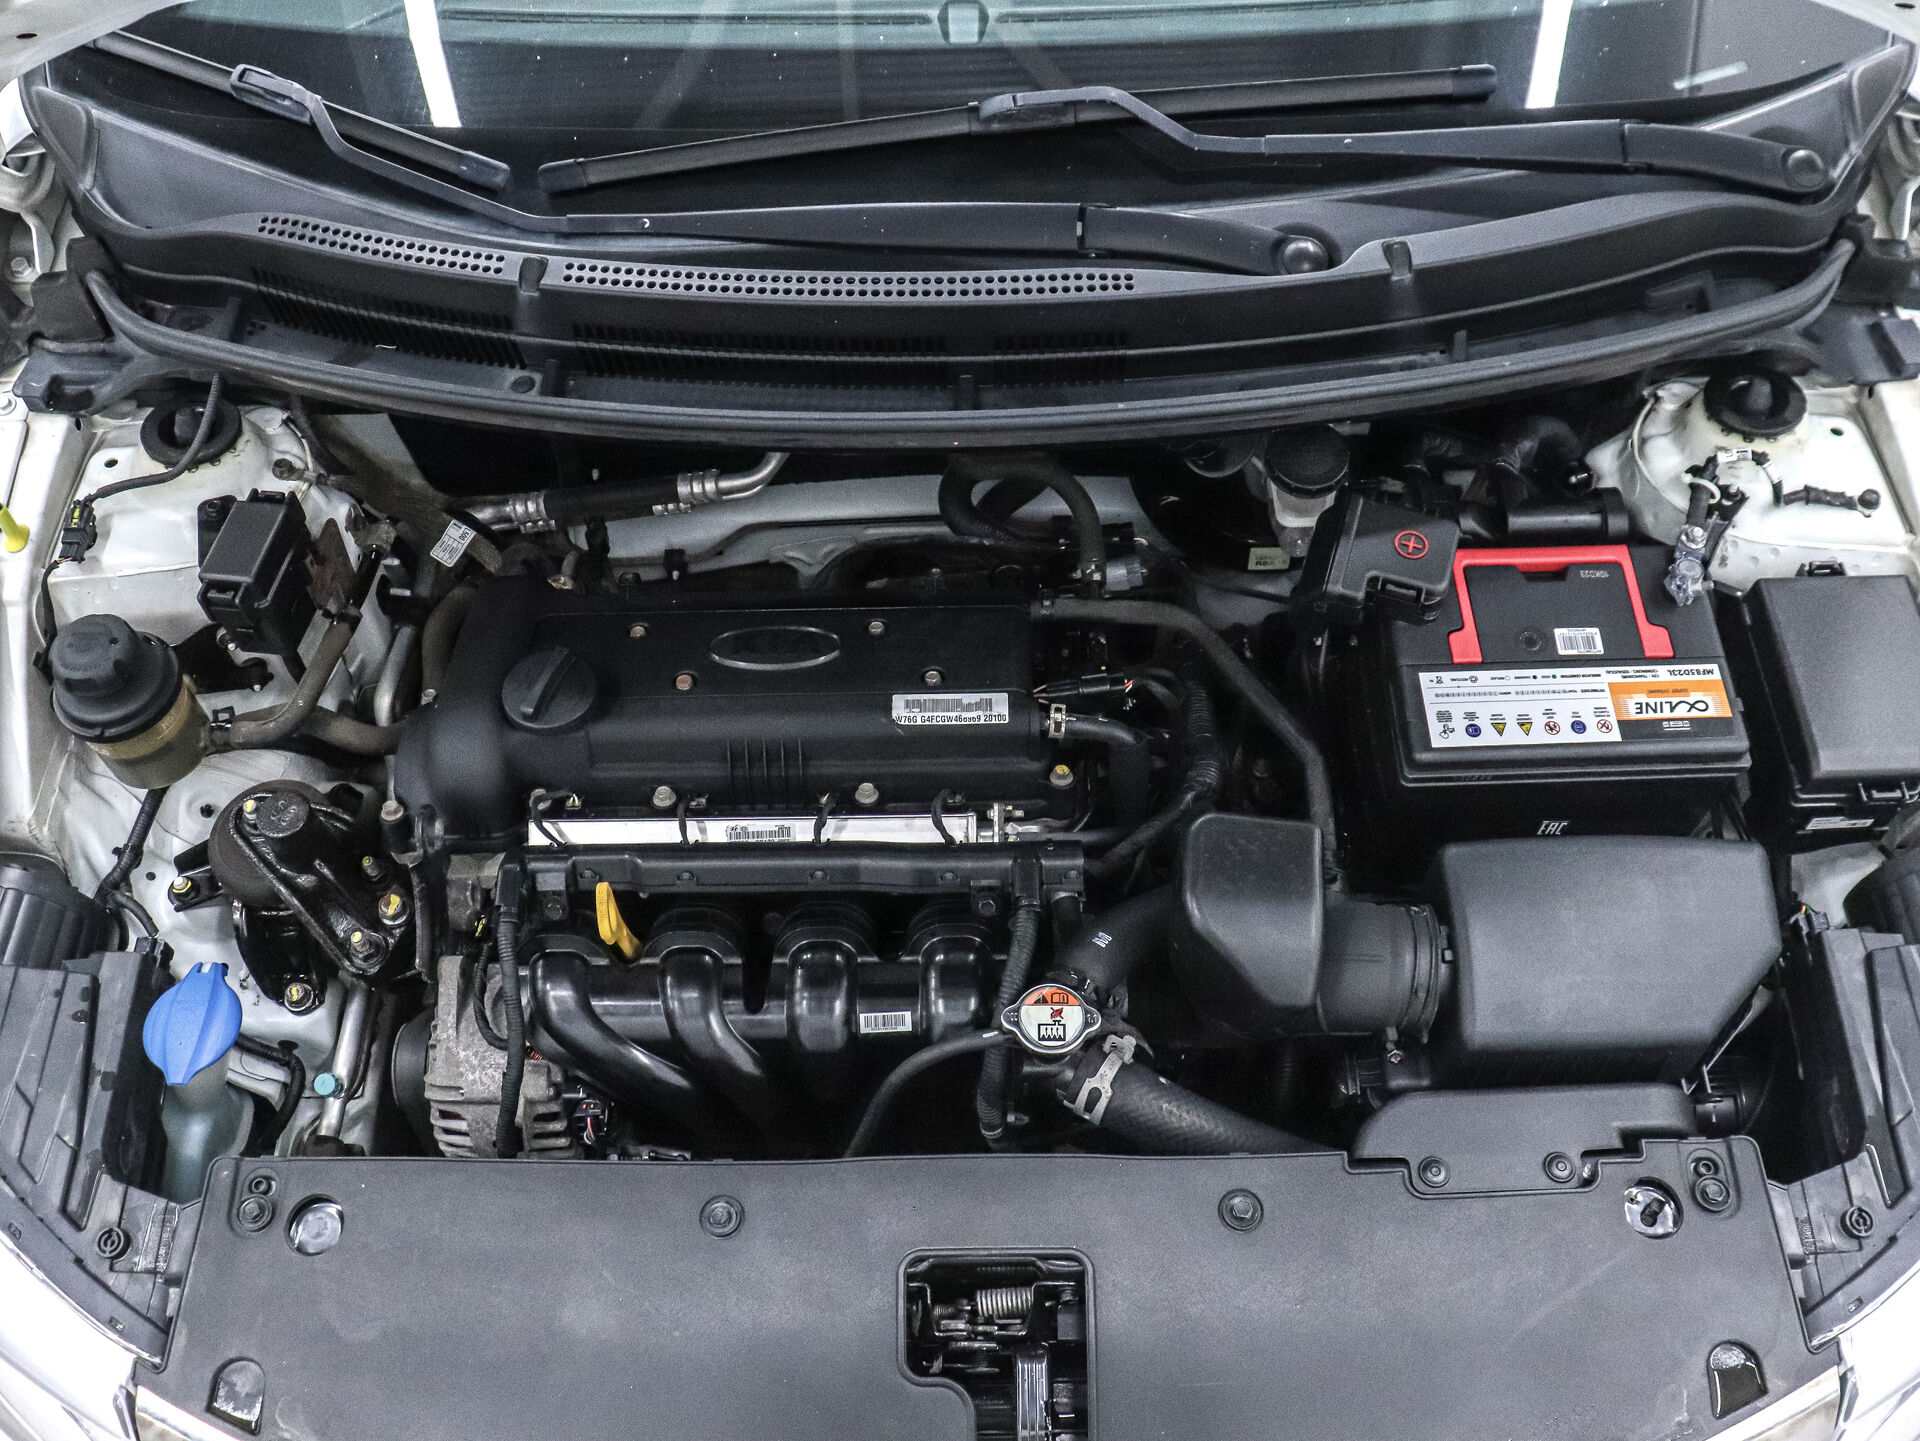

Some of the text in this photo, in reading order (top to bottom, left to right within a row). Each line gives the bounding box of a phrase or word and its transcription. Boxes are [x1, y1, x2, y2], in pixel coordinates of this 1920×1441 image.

[1666, 668, 1714, 677] MF85D23L
[895, 715, 918, 724] W76G
[1536, 821, 1568, 836] EAC
